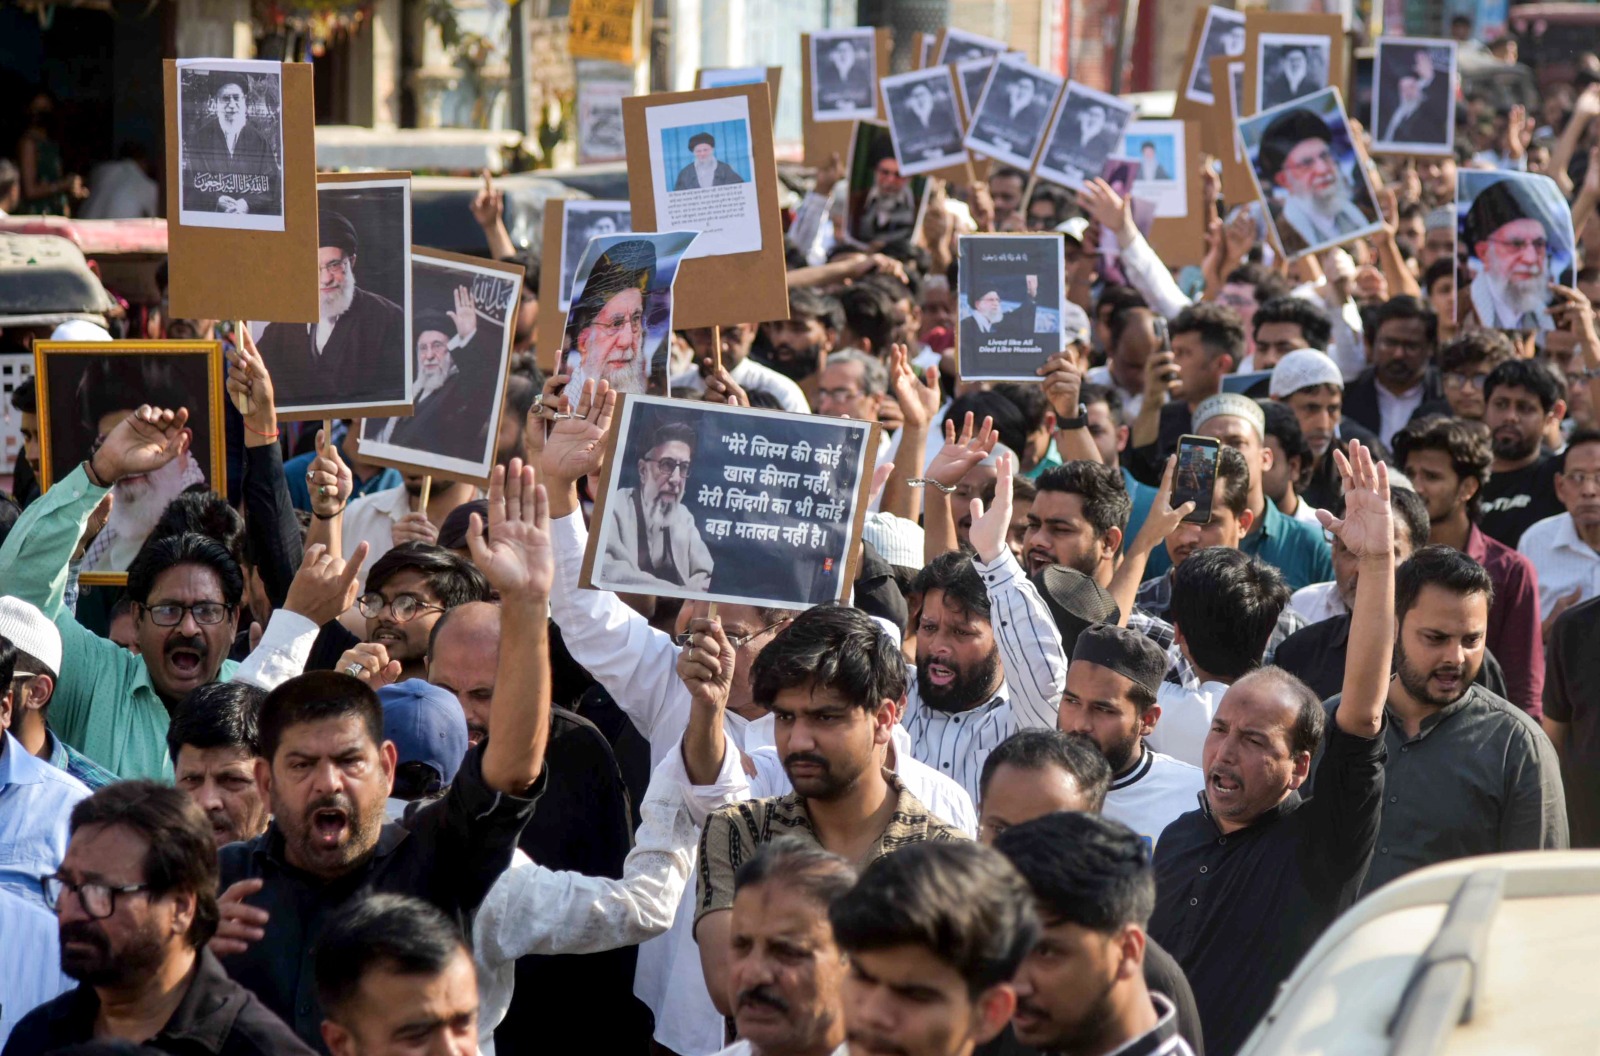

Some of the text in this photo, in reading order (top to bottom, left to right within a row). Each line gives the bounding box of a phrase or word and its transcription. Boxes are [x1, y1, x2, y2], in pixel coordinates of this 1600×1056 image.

[979, 345, 1042, 353] Died Like Hussain
[988, 338, 1008, 346] Lived
[1023, 338, 1034, 346] Ali
[721, 432, 842, 469] "मेरे जिस्म की कोई
[723, 464, 832, 496] खास कीमत नहीं,
[698, 484, 845, 524] मेरी ज़िंदगी का भी कोई
[705, 518, 828, 549] बड़ा मतलब नहीं है।
